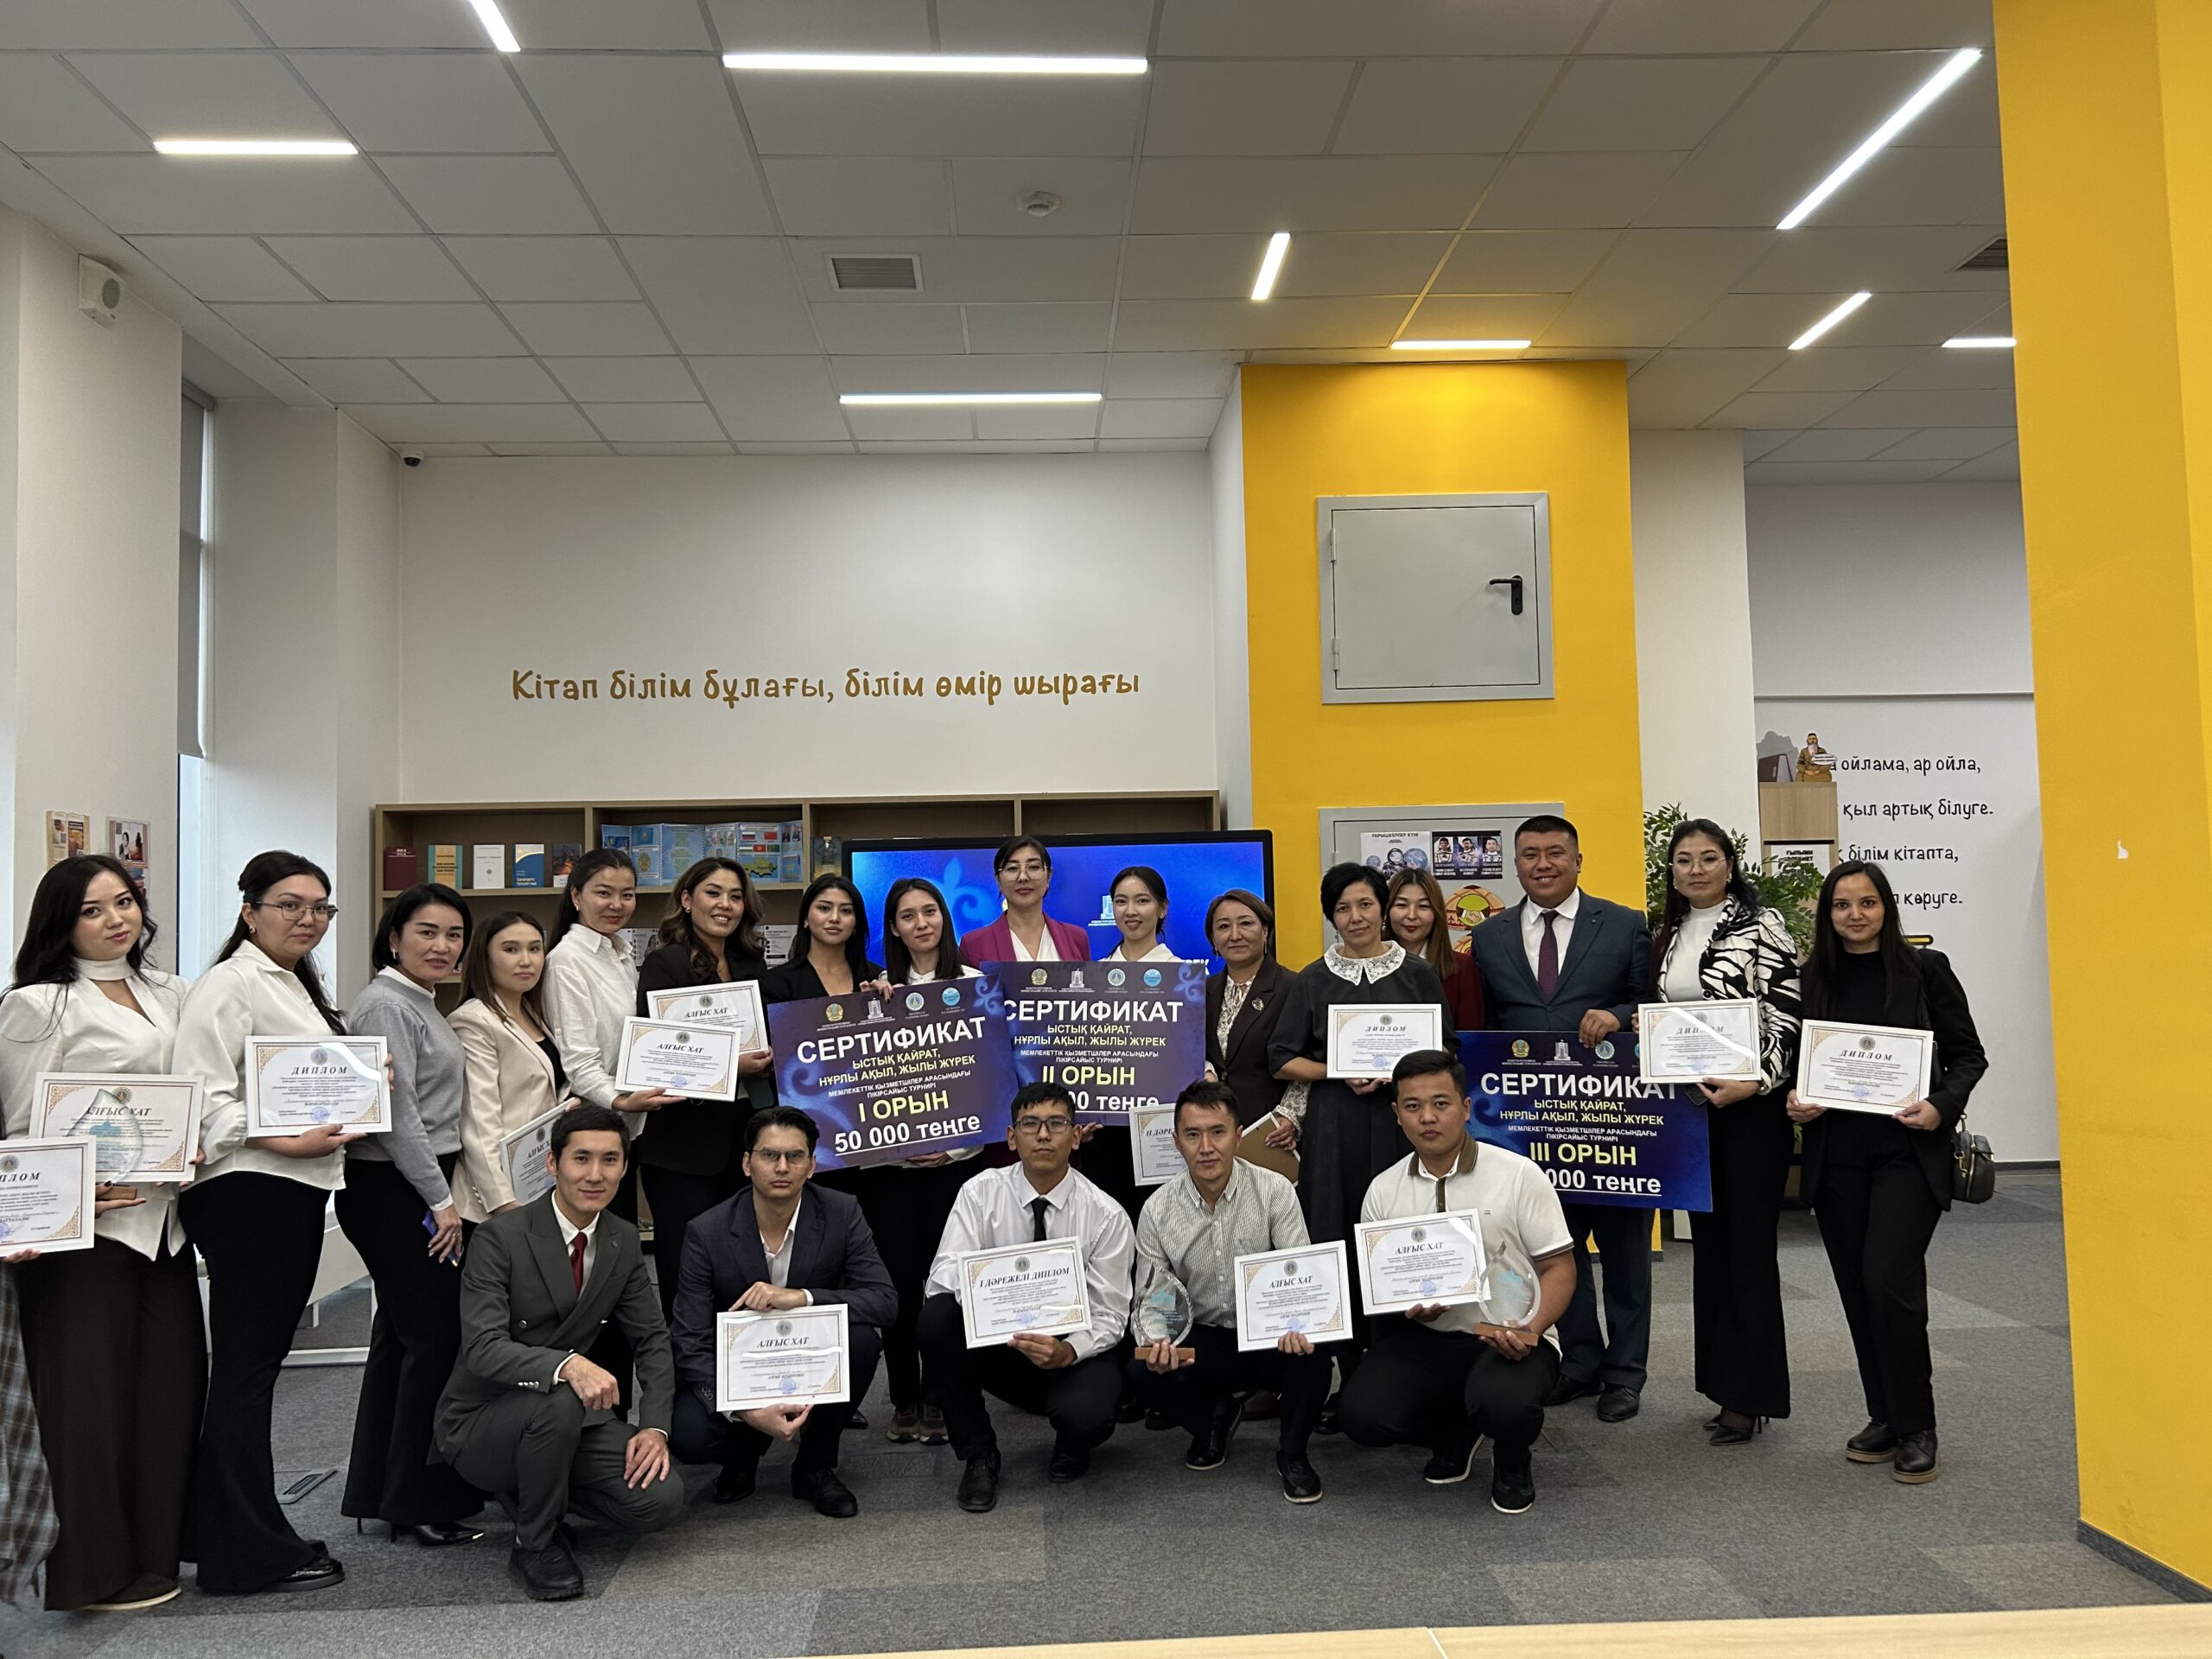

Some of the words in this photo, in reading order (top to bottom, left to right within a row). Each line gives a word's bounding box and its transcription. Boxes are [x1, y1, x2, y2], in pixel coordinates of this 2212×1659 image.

[513, 670, 597, 700] Кітап
[610, 670, 691, 699] білім
[703, 669, 834, 709] бұлағы,
[845, 668, 924, 697] білім
[936, 671, 1001, 705] өмір
[1014, 672, 1139, 706] шырағы
[1841, 756, 1910, 773] ойлама,
[1913, 759, 1931, 776] ар
[1936, 755, 1980, 773] ойла,
[1843, 804, 1877, 821] қыл
[1883, 803, 1934, 822] артық
[1938, 798, 1993, 820] білуге.
[1848, 844, 1889, 861] білім
[1894, 846, 1959, 863] кітапта,
[1904, 892, 1963, 910] көруге.
[1004, 1000, 1183, 1022] СЕРТИФИКАТ
[1047, 1025, 1087, 1035] ЫСТЫҚ
[1090, 1023, 1132, 1035] ҚАЙРАТ,
[1676, 1026, 1724, 1035] ДИПМ
[798, 1016, 986, 1064] СЕРТИФИКАТ
[1014, 1036, 1050, 1045] НҰРЛЫ
[1053, 1036, 1087, 1047] АҚЫЛ,
[1090, 1037, 1127, 1046] ЖЫЛЫ
[1130, 1037, 1166, 1046] ЖҮРЕК
[853, 1056, 895, 1070] ЫСТЫҚ
[898, 1048, 941, 1064] ҚАЙРАТ,
[1840, 1050, 1893, 1061] ДИПЛОМ
[291, 1066, 347, 1075] ДИПЛОМ
[819, 1073, 858, 1087] НҰРЛЫ
[861, 1069, 897, 1083] АҚЫЛ,
[899, 1062, 937, 1075] ЖЫЛЫ
[940, 1055, 976, 1069] ЖҮРЕК
[1062, 1066, 1135, 1085] ОРЫН
[829, 1085, 874, 1096] МЕМЛЕКЕТТІК
[873, 1090, 949, 1120] ОРЫН
[1535, 1099, 1577, 1110] ЫСТЫҚ
[1580, 1099, 1626, 1112] ҚАЙРАТ,
[1500, 1111, 1539, 1120] НҰРЛЫ
[1542, 1112, 1579, 1122] АҚЫЛ,
[1580, 1113, 1621, 1123] ЖЫЛЫ
[1624, 1115, 1663, 1125] ЖҮРЕК
[835, 1131, 862, 1152] 50
[869, 1122, 910, 1143] 000
[917, 1116, 980, 1139] теңге
[1153, 1128, 1174, 1137] ДӘРЕ
[1558, 1143, 1637, 1166] ОРЫН
[0, 1173, 41, 1182] ПЛОМ
[1592, 1174, 1661, 1193] теңге
[1395, 1244, 1427, 1255] АЛҒЫС
[1032, 1267, 1070, 1280] ДИПЛОМ
[1268, 1278, 1296, 1288] АЛҒЫС
[1297, 1275, 1313, 1285] ХАТ
[757, 1338, 791, 1348] АЛҒЫС
[791, 1337, 809, 1345] ХАТ
